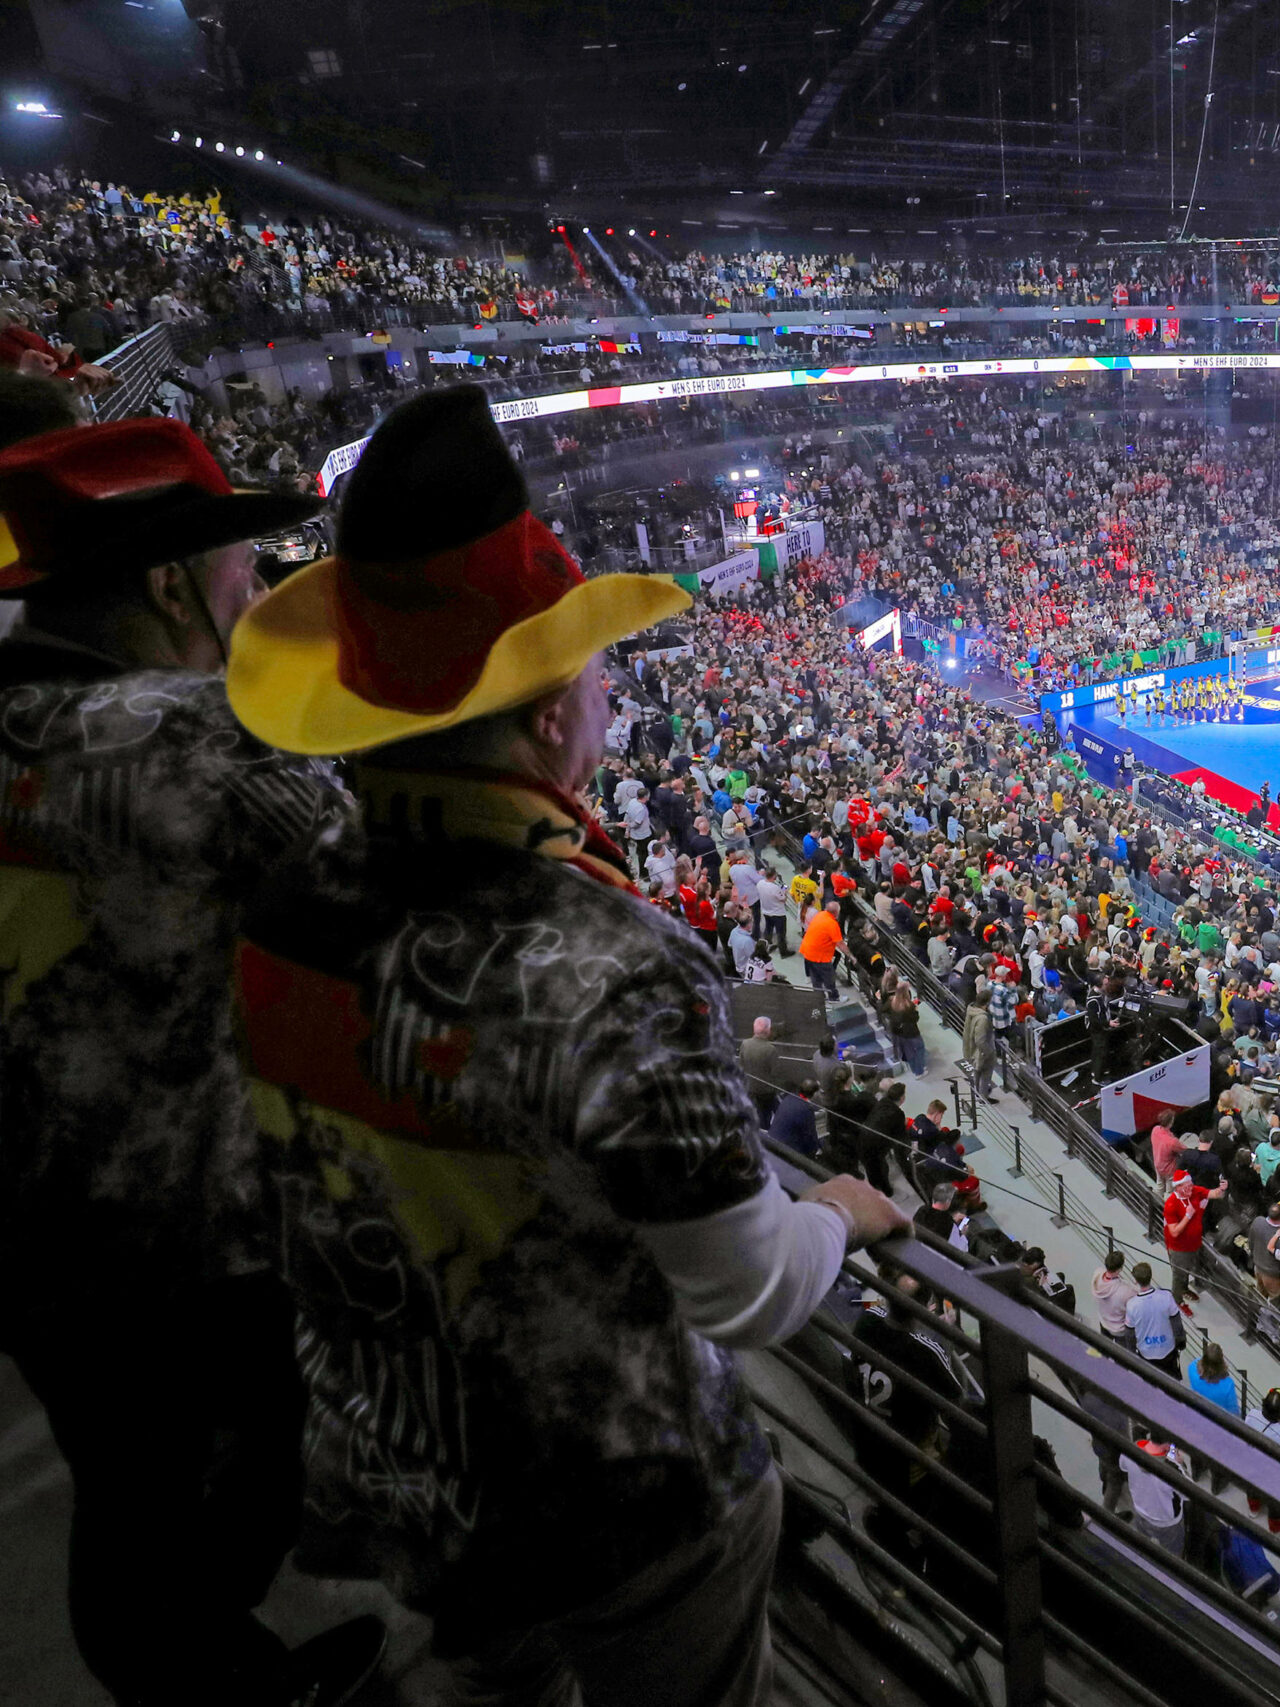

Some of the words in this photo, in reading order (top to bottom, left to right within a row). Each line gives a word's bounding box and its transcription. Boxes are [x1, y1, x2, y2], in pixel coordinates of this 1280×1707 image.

[1216, 356, 1227, 366] EHF
[1230, 356, 1248, 366] EURO
[1249, 356, 1268, 366] 2024
[692, 380, 705, 393] EHF
[707, 378, 725, 391] EURO
[727, 376, 746, 389] 2024
[502, 403, 520, 419] EURO
[520, 400, 538, 416] 2024
[786, 535, 801, 553] HERE
[802, 529, 811, 547] TO
[1060, 692, 1075, 708] 18
[1094, 683, 1119, 701] HANS
[747, 966, 754, 980] 3
[1149, 1066, 1167, 1082] EHF
[1144, 1335, 1166, 1345] DKB
[858, 1362, 893, 1417] 12
